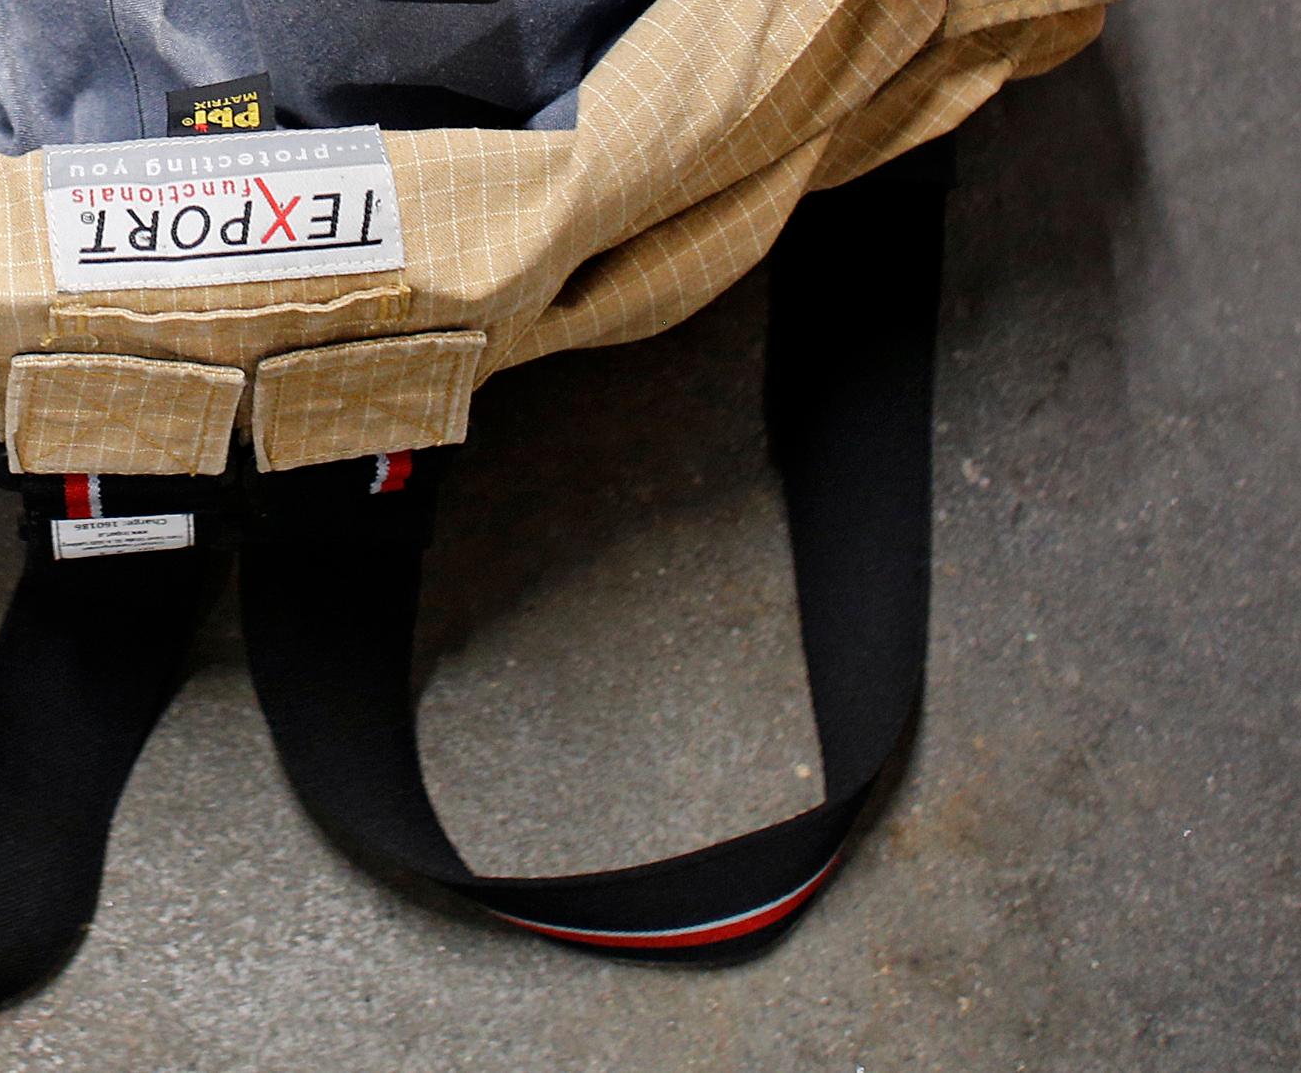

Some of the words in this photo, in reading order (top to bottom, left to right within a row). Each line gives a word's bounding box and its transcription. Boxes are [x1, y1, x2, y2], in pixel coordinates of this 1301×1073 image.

[193, 91, 258, 111] MATRIX
[69, 159, 129, 178] you
[71, 177, 251, 207] functionals
